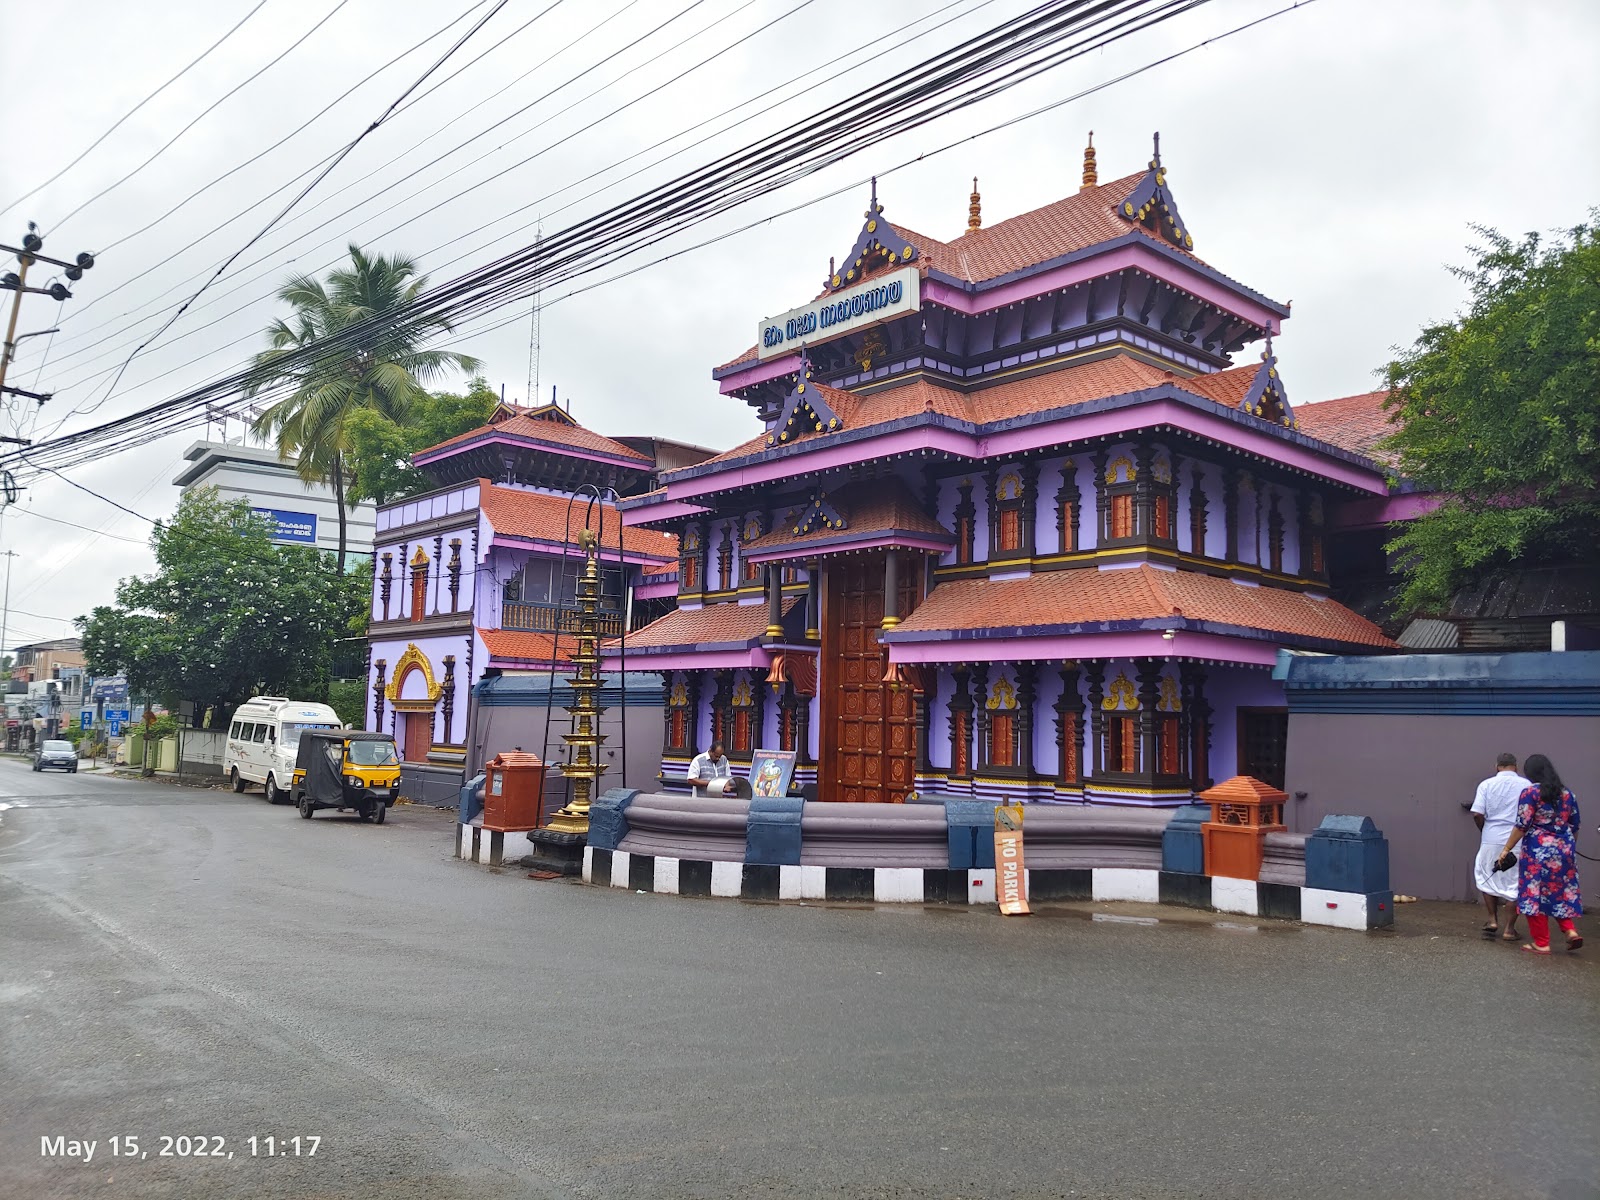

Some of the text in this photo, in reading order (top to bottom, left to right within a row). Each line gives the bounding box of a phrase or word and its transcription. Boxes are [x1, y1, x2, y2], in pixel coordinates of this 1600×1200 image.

[763, 280, 903, 348] ഓം നമോ നാരായണായ
[1002, 838, 1017, 858] NO
